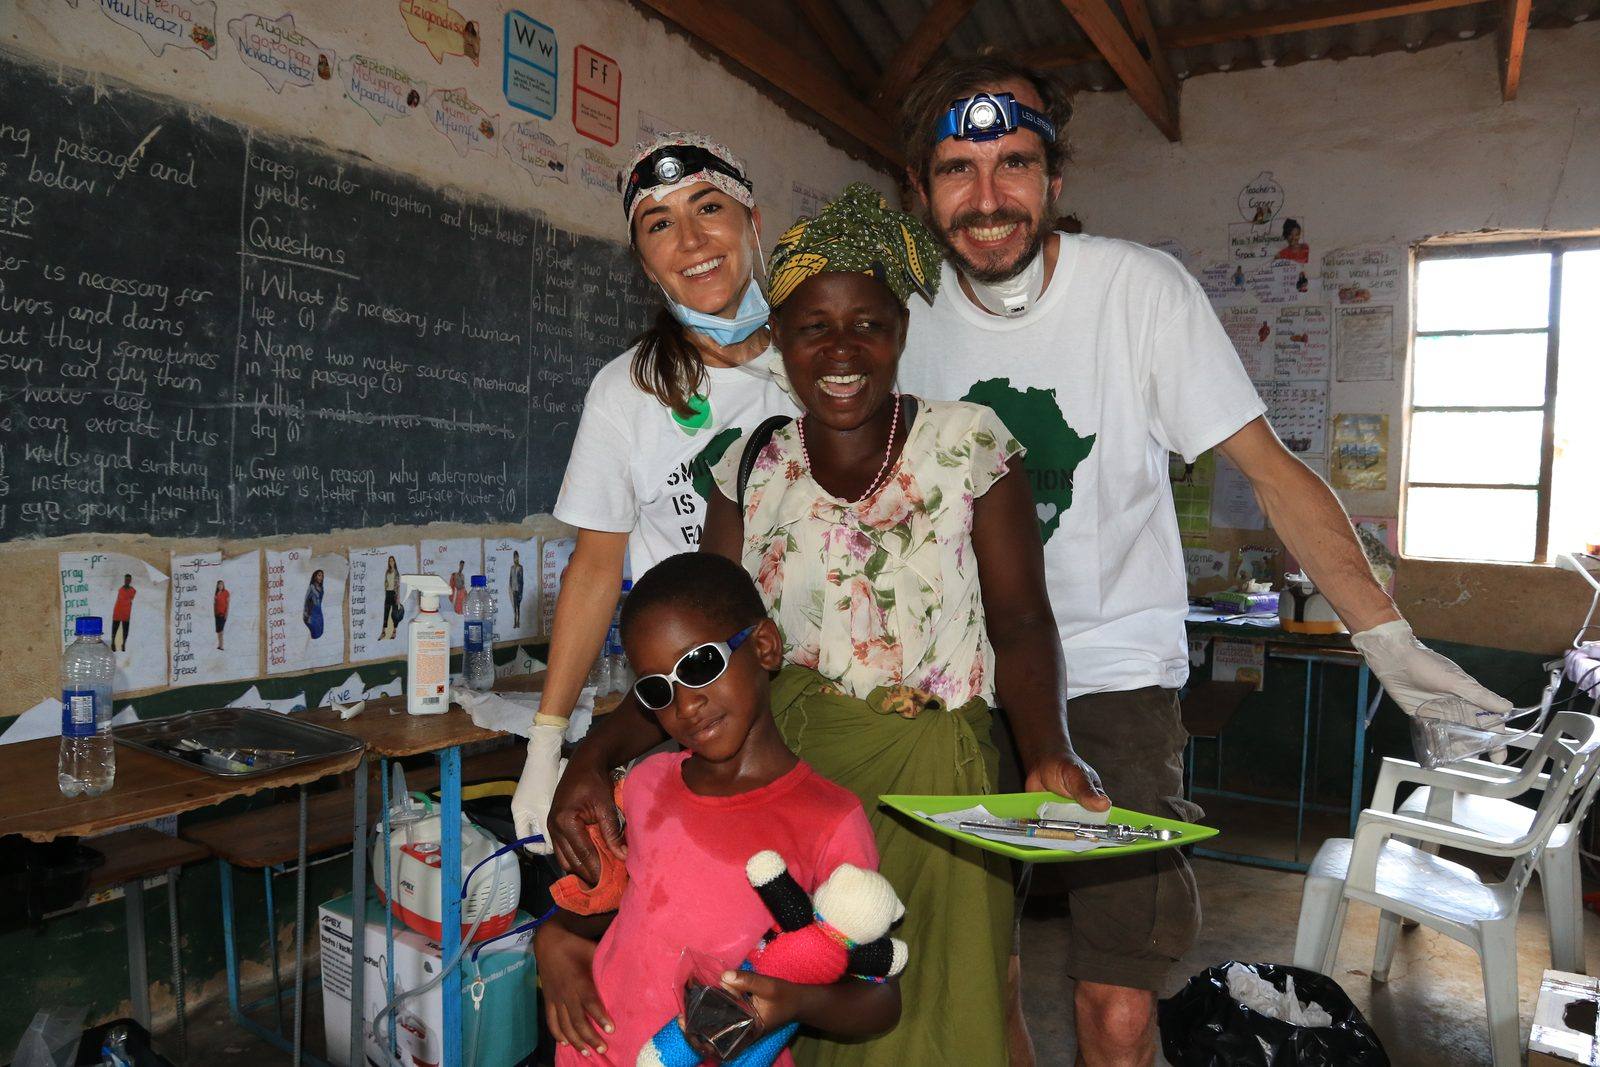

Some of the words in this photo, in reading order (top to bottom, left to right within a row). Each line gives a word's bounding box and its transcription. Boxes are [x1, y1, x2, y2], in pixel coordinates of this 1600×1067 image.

[255, 16, 306, 47] August
[355, 54, 412, 84] September
[55, 137, 140, 180] passage
[150, 159, 197, 188] and
[251, 153, 297, 181] crops
[308, 166, 359, 195] under
[370, 188, 432, 217] irrigation
[440, 208, 463, 229] and
[497, 222, 528, 247] better
[249, 216, 346, 265] Questions
[44, 264, 65, 281] is
[79, 270, 169, 311] necessary
[175, 288, 214, 306] for
[581, 264, 601, 277] two
[1367, 280, 1394, 290] serve
[69, 293, 114, 325] and
[122, 300, 184, 336] dams
[260, 269, 324, 307] What
[335, 284, 349, 312] is
[357, 300, 427, 337] necessary
[461, 306, 521, 346] human
[544, 294, 567, 316] Find
[575, 298, 590, 322] the
[594, 301, 619, 328] word
[44, 316, 102, 366] they
[113, 340, 220, 370] sometimes
[536, 321, 573, 338] means
[580, 324, 595, 341] the
[0, 352, 43, 374] sun
[60, 361, 97, 379] can
[107, 356, 147, 396] dry
[153, 362, 202, 393] them
[254, 331, 314, 361] Name
[325, 346, 354, 366] two
[363, 354, 413, 373] water
[472, 375, 531, 396] mentioned
[543, 339, 573, 375] Why
[24, 384, 92, 405] water
[246, 361, 261, 376] in
[271, 356, 301, 380] the
[311, 368, 379, 399] passage
[431, 408, 457, 431] and
[543, 392, 567, 414] Give
[28, 415, 69, 434] can
[86, 411, 160, 439] extract
[172, 408, 219, 446] this
[251, 413, 277, 456] dry
[94, 436, 133, 471] and
[141, 440, 208, 487] sinking
[250, 457, 286, 482] Give
[292, 466, 319, 481] one
[330, 466, 376, 484] reason
[389, 458, 419, 491] why
[427, 459, 507, 491] underground
[32, 470, 104, 495] instead
[116, 481, 143, 503] of
[245, 482, 290, 499] water
[299, 483, 310, 498] is
[320, 480, 358, 501] better
[366, 481, 396, 503] than
[672, 494, 696, 516] IS
[174, 612, 192, 627] grin
[321, 915, 342, 930] APEX
